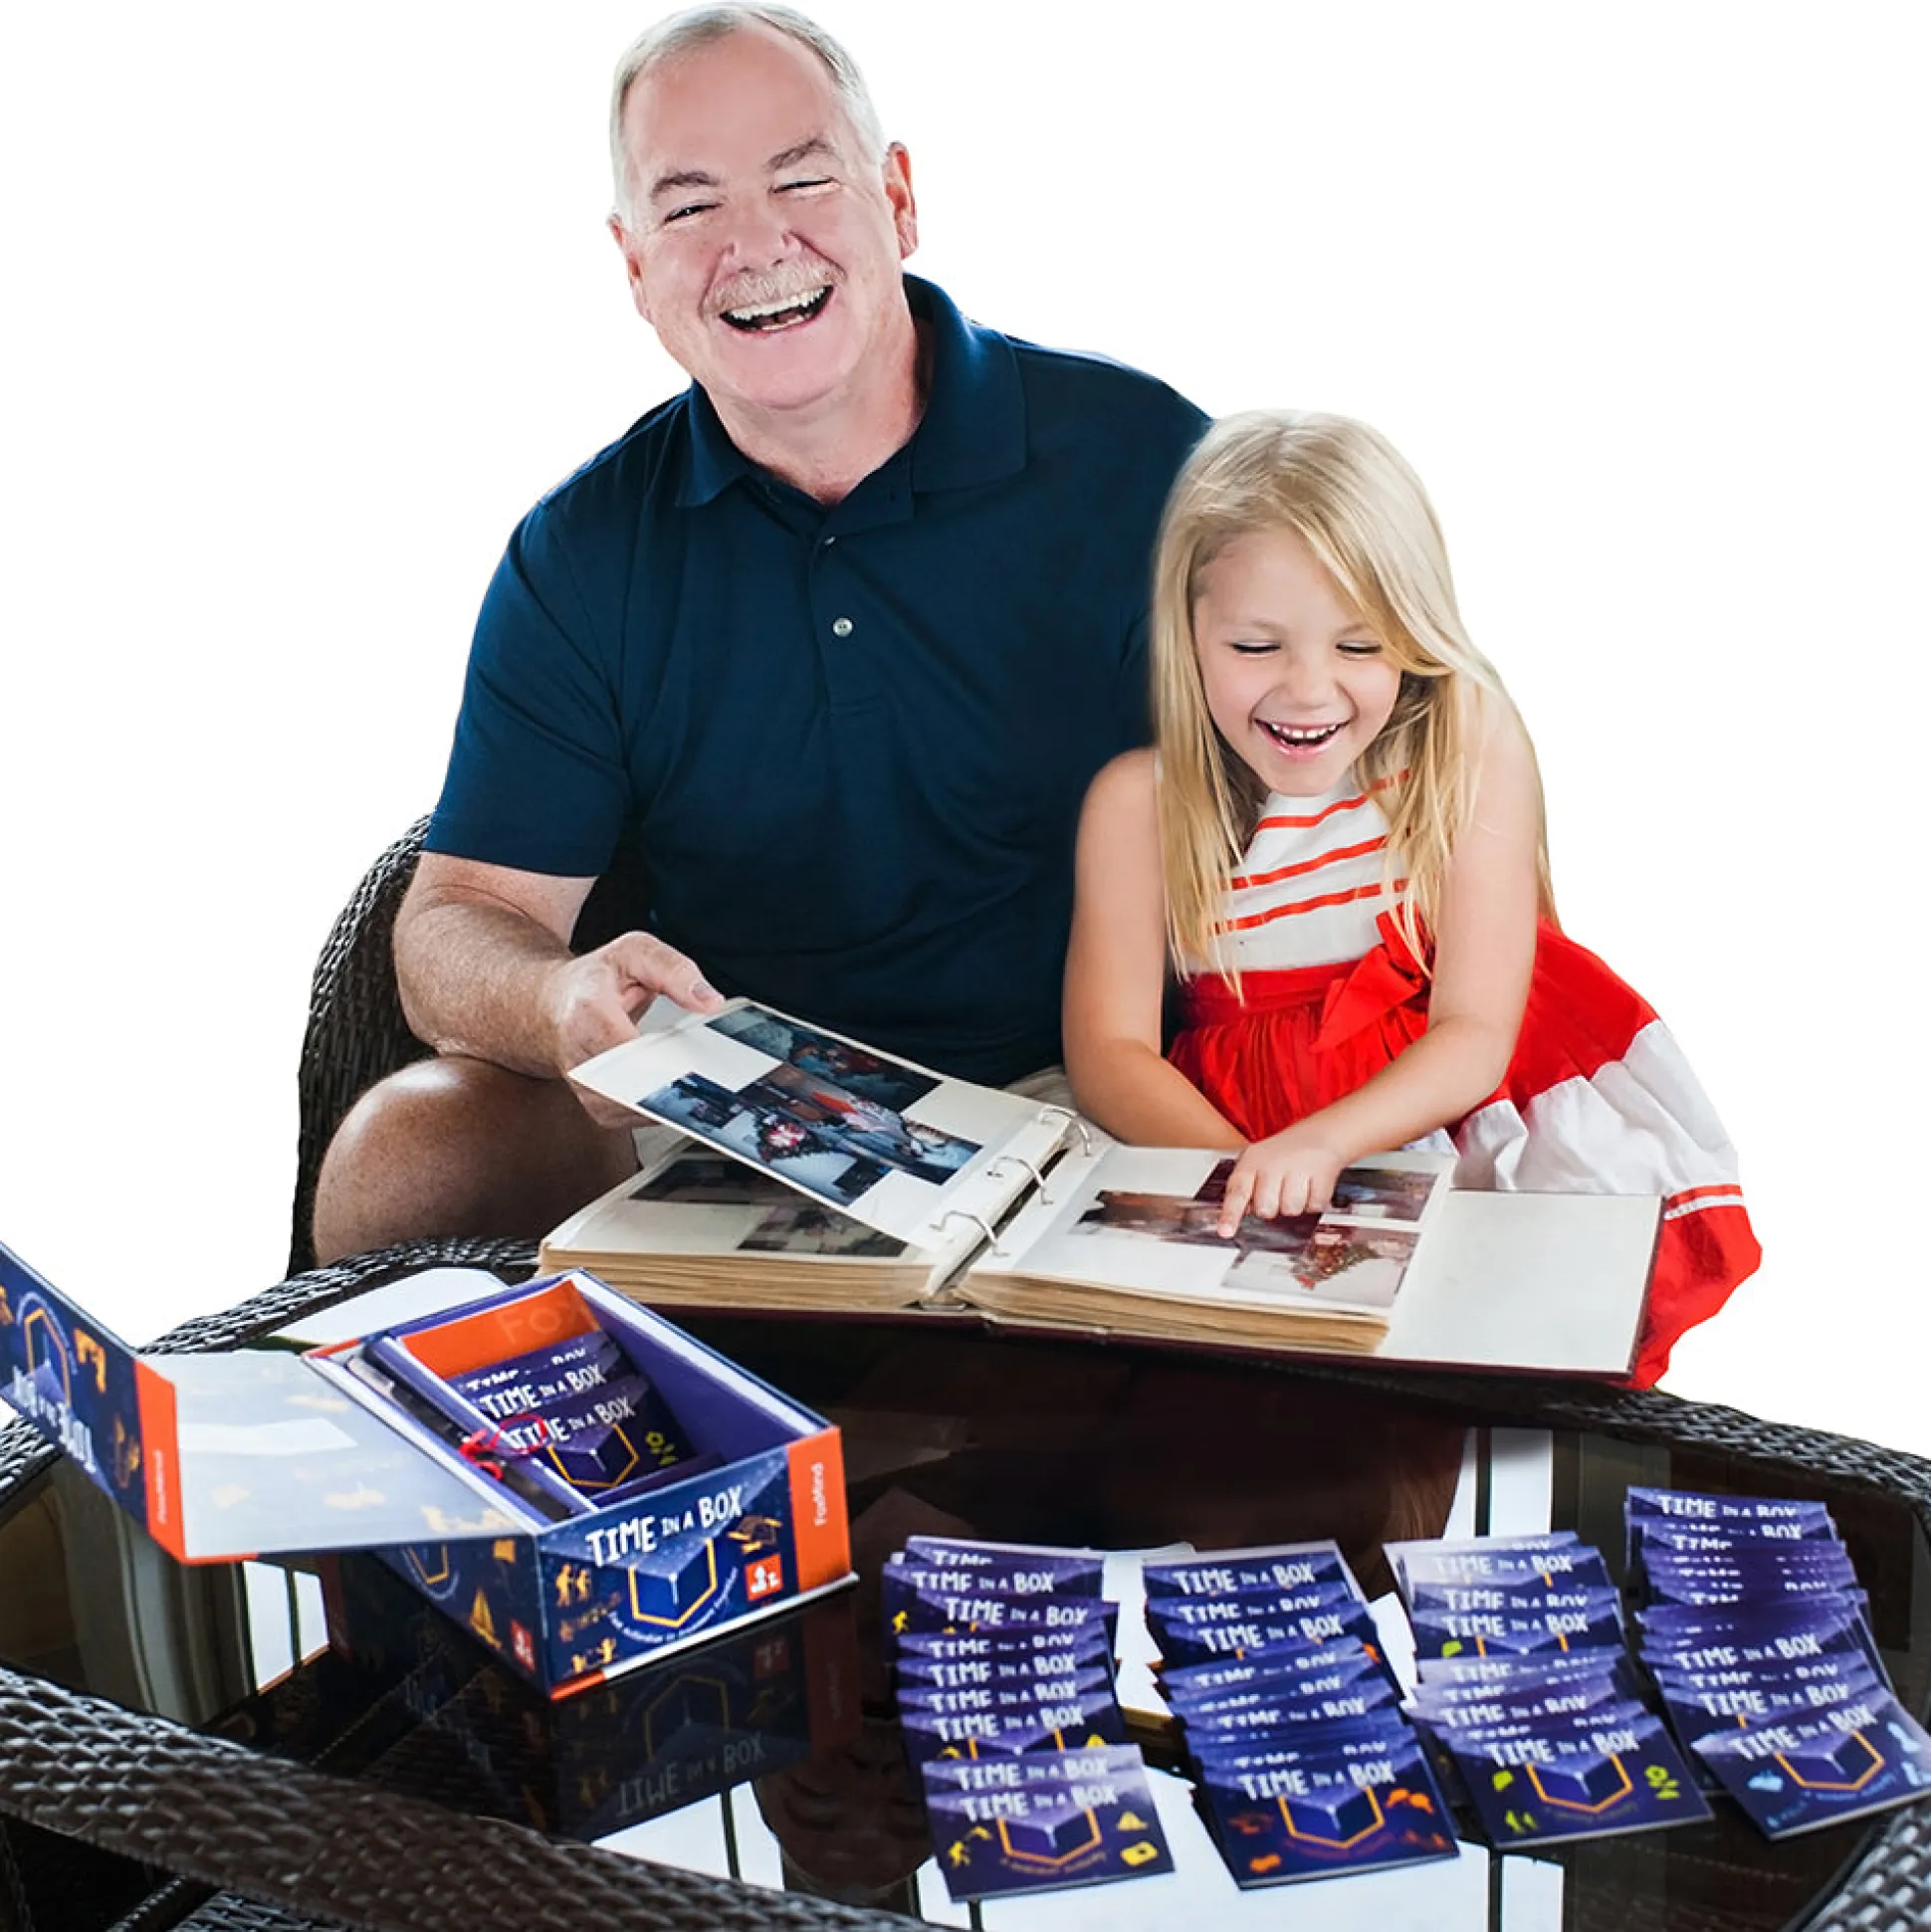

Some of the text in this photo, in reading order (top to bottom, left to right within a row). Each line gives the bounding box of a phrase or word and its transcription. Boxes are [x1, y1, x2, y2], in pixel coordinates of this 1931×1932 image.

[479, 1384, 541, 1418] TIME
[556, 1380, 567, 1394] A
[565, 1364, 606, 1393] BOX
[585, 1412, 596, 1425] A
[593, 1395, 635, 1424] BOX
[1656, 1495, 1717, 1518] TIME
[1742, 1506, 1752, 1517] A
[585, 1485, 744, 1568] TIME IN A BOX
[911, 1571, 971, 1592] TIME
[997, 1578, 1008, 1590] A
[1013, 1571, 1055, 1593] BOX
[1172, 1568, 1238, 1596] TIME
[1260, 1571, 1271, 1584] A
[1271, 1561, 1316, 1588] BOX
[1517, 1559, 1527, 1570] A
[1530, 1555, 1574, 1574] BOX
[944, 1597, 1089, 1626] TIME IN A BOX
[1443, 1589, 1504, 1611] TIME
[1196, 1624, 1265, 1653] TIME
[1288, 1625, 1299, 1636] A
[1299, 1613, 1344, 1639] BOX
[1442, 1613, 1506, 1638] TIME
[1530, 1618, 1541, 1630] A
[1546, 1612, 1590, 1633] BOX
[1673, 1647, 1739, 1670] TIME
[1764, 1646, 1776, 1658] A
[1774, 1633, 1823, 1659] BOX
[928, 1661, 991, 1687] TIME
[1020, 1663, 1029, 1675] A
[1032, 1653, 1076, 1676] BOX
[928, 1690, 992, 1713] TIME
[1439, 1704, 1506, 1728] TIME
[1697, 1689, 1769, 1717] TIME
[1793, 1693, 1804, 1705] A
[1805, 1682, 1849, 1706] BOX
[932, 1705, 1085, 1742] TIME IN A BOX
[1728, 1726, 1801, 1762] TIME
[1818, 1720, 1830, 1732] A
[1826, 1703, 1878, 1732] BOX
[1484, 1729, 1640, 1768] TIME IN A BOX
[954, 1762, 1023, 1792] TIME
[1048, 1764, 1060, 1777] A
[1063, 1757, 1110, 1781] BOX
[1237, 1769, 1310, 1802] TIME
[1335, 1771, 1346, 1784] A
[1348, 1761, 1395, 1788] BOX
[960, 1792, 1030, 1823] TIME
[1056, 1795, 1067, 1807] A
[1070, 1785, 1119, 1810] BOX
